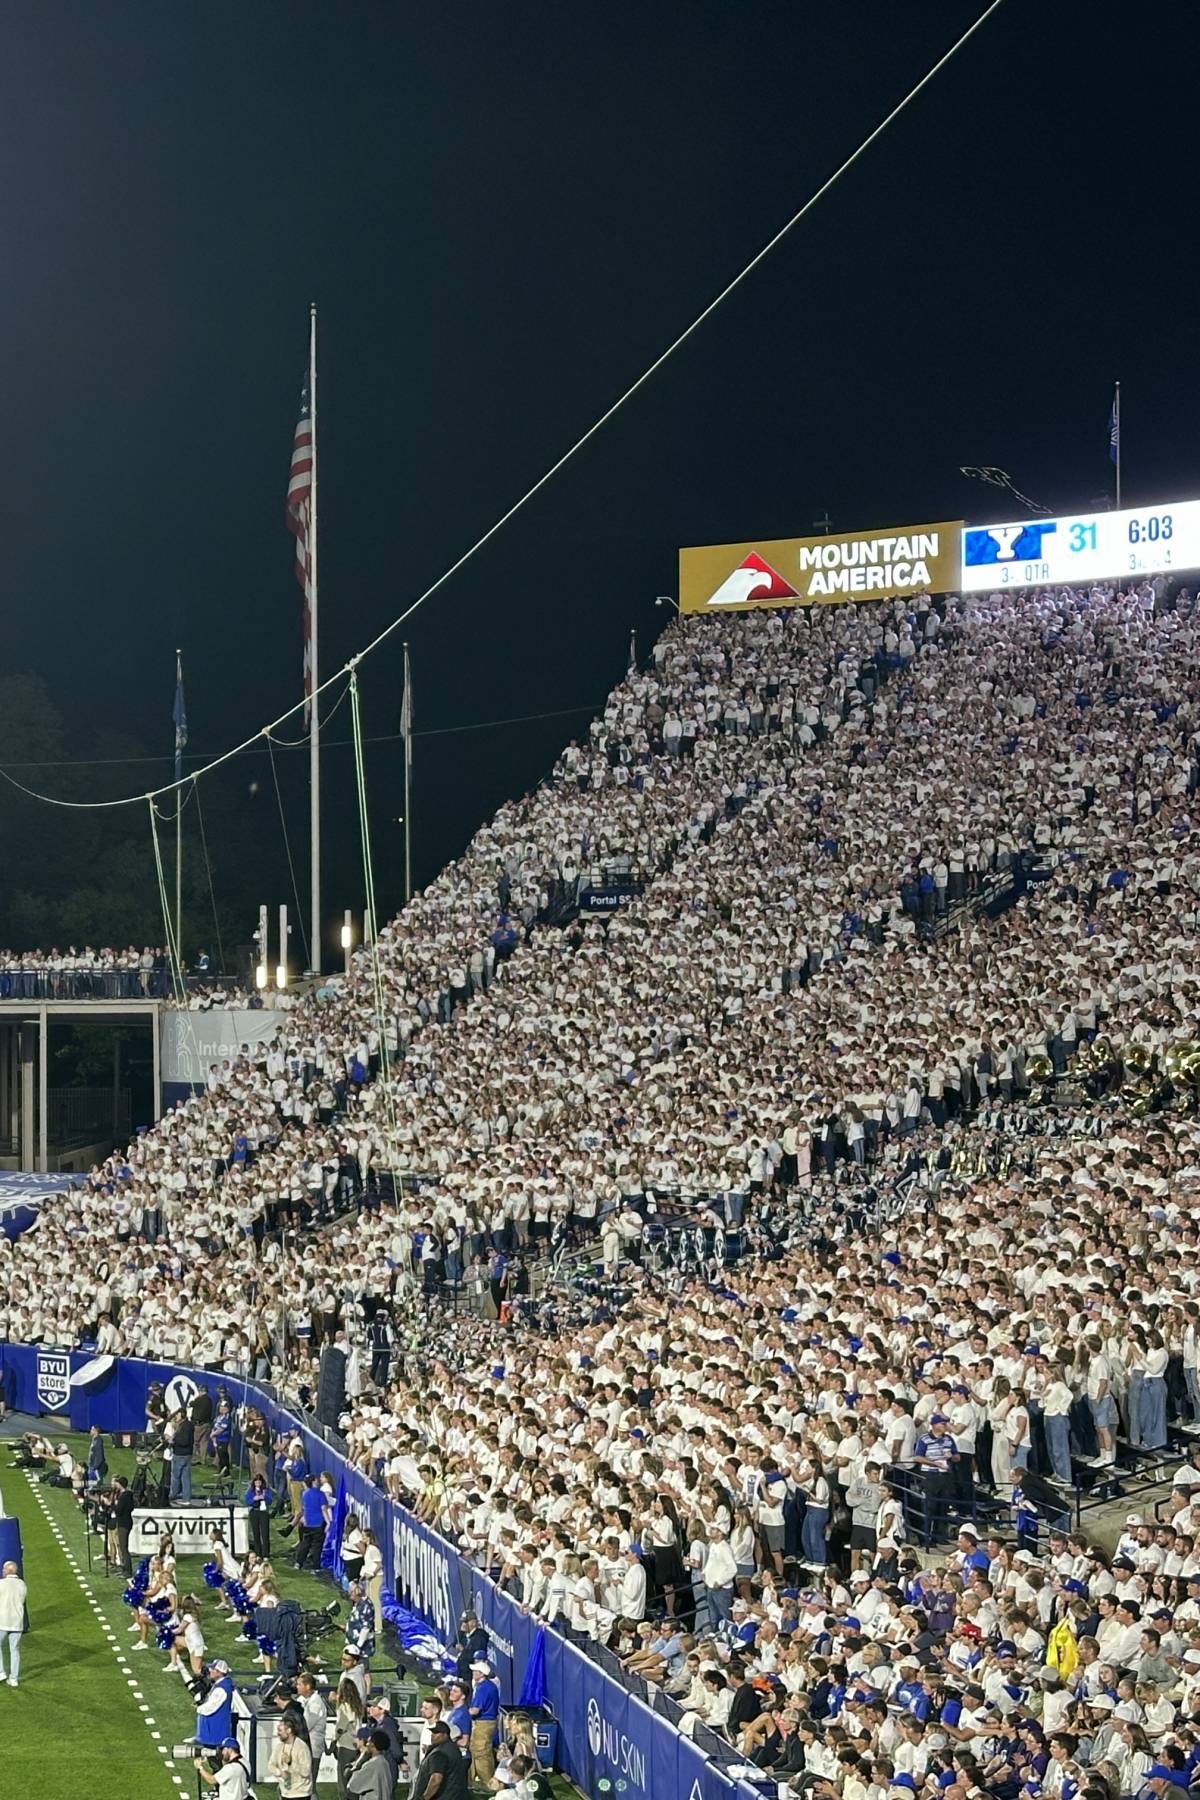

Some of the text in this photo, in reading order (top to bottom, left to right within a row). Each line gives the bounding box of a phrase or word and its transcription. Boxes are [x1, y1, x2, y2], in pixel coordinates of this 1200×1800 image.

[1069, 515, 1173, 552] 31 6:03
[800, 533, 939, 571] MOUNTAIN
[807, 561, 931, 596] AMERICA
[590, 896, 617, 904] Portal
[40, 1360, 65, 1374] BYU
[40, 1376, 66, 1389] store
[602, 1718, 646, 1792] NU SKIN
